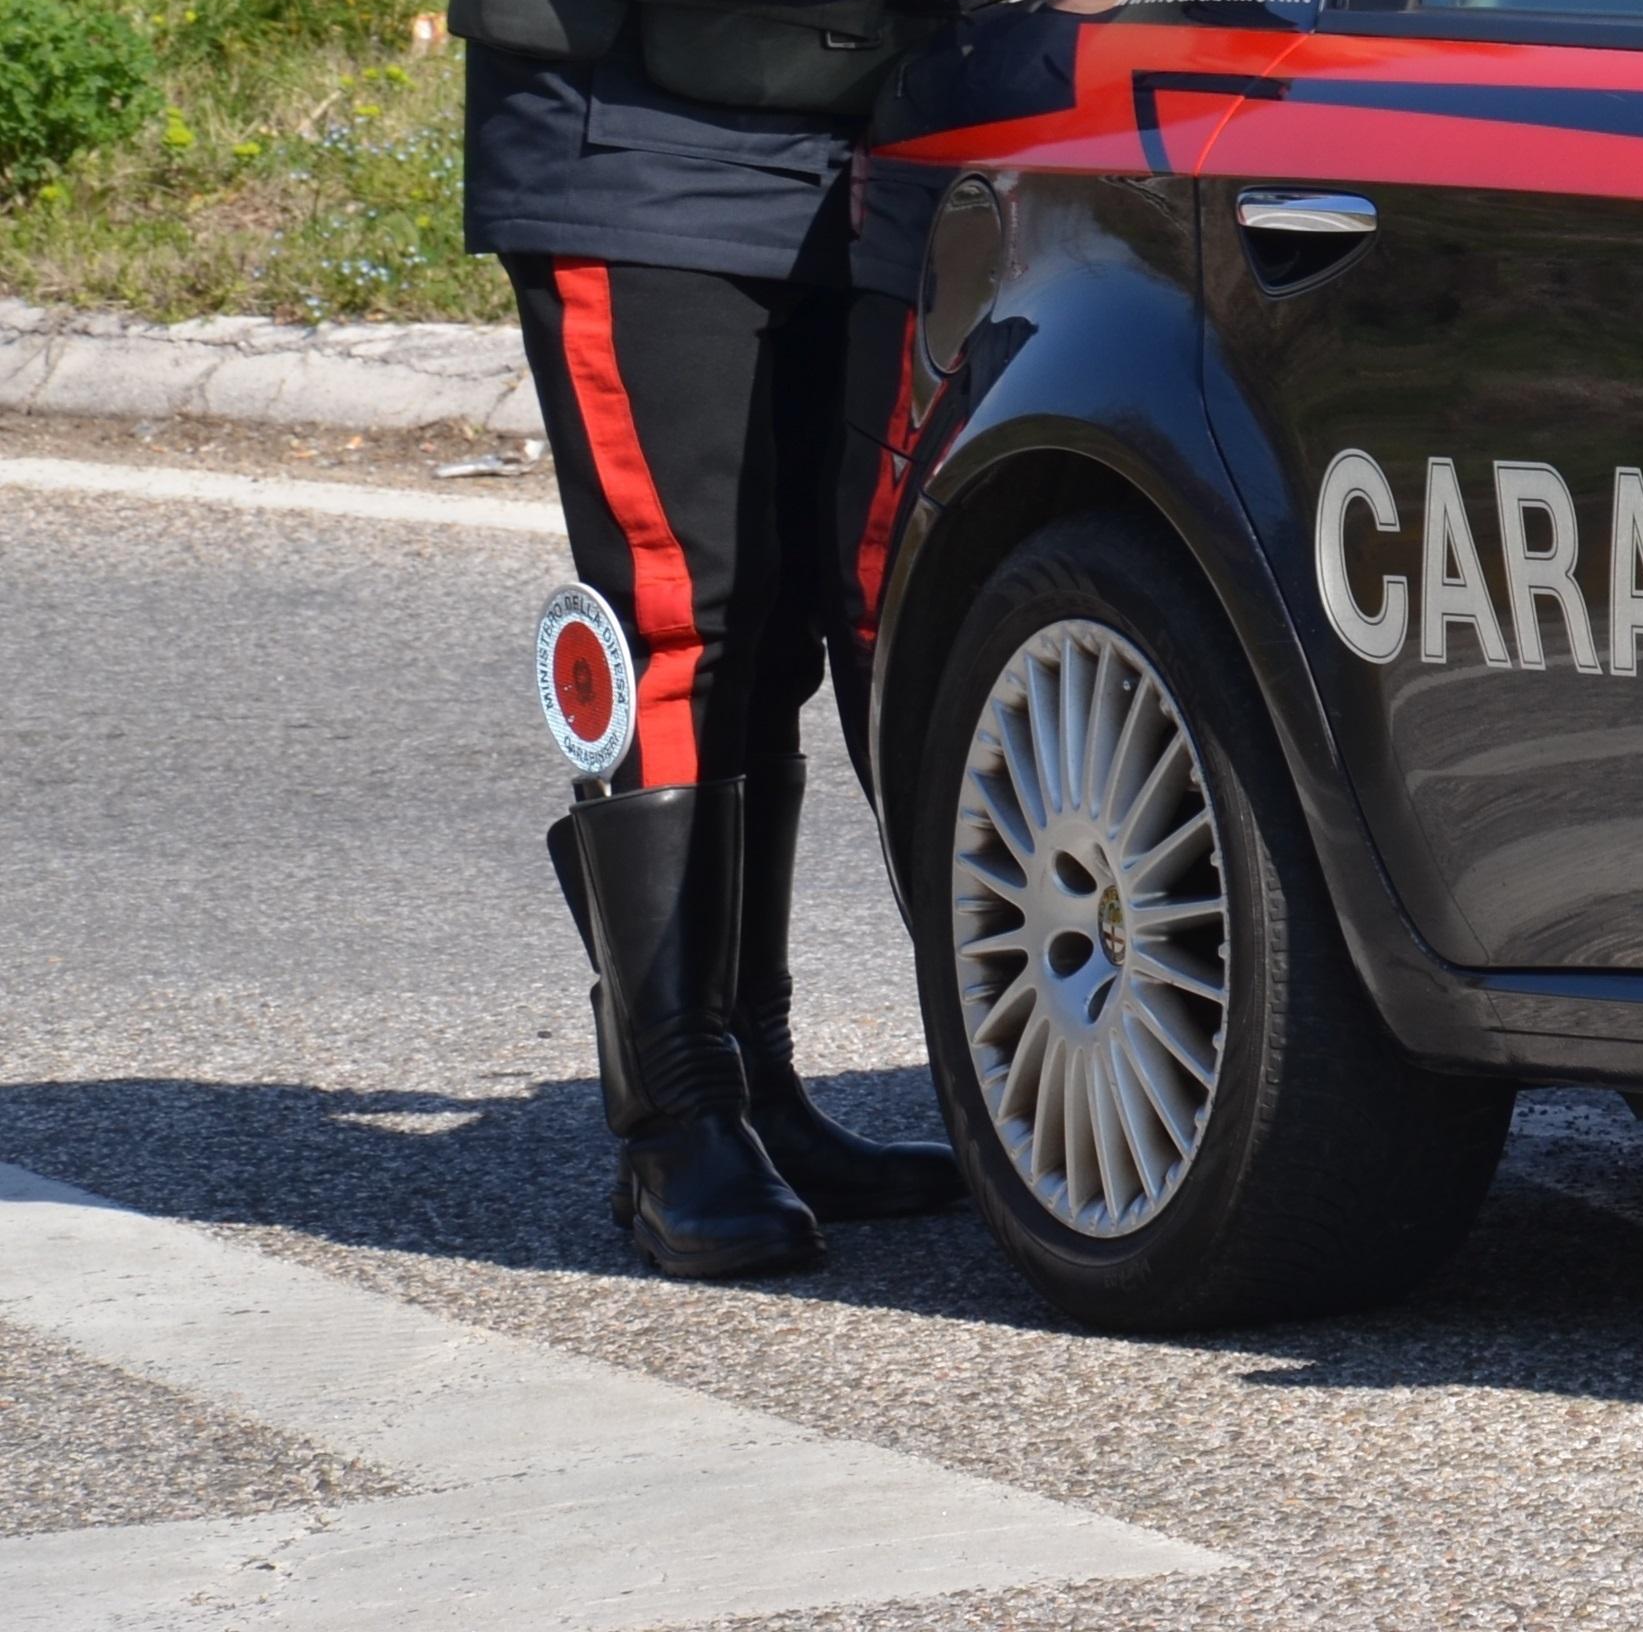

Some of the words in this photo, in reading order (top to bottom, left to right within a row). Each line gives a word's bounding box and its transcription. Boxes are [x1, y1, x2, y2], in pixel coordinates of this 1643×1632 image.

[537, 602, 563, 710] MINISTERO
[564, 595, 601, 629] DELLA
[602, 626, 626, 705] DIFESA
